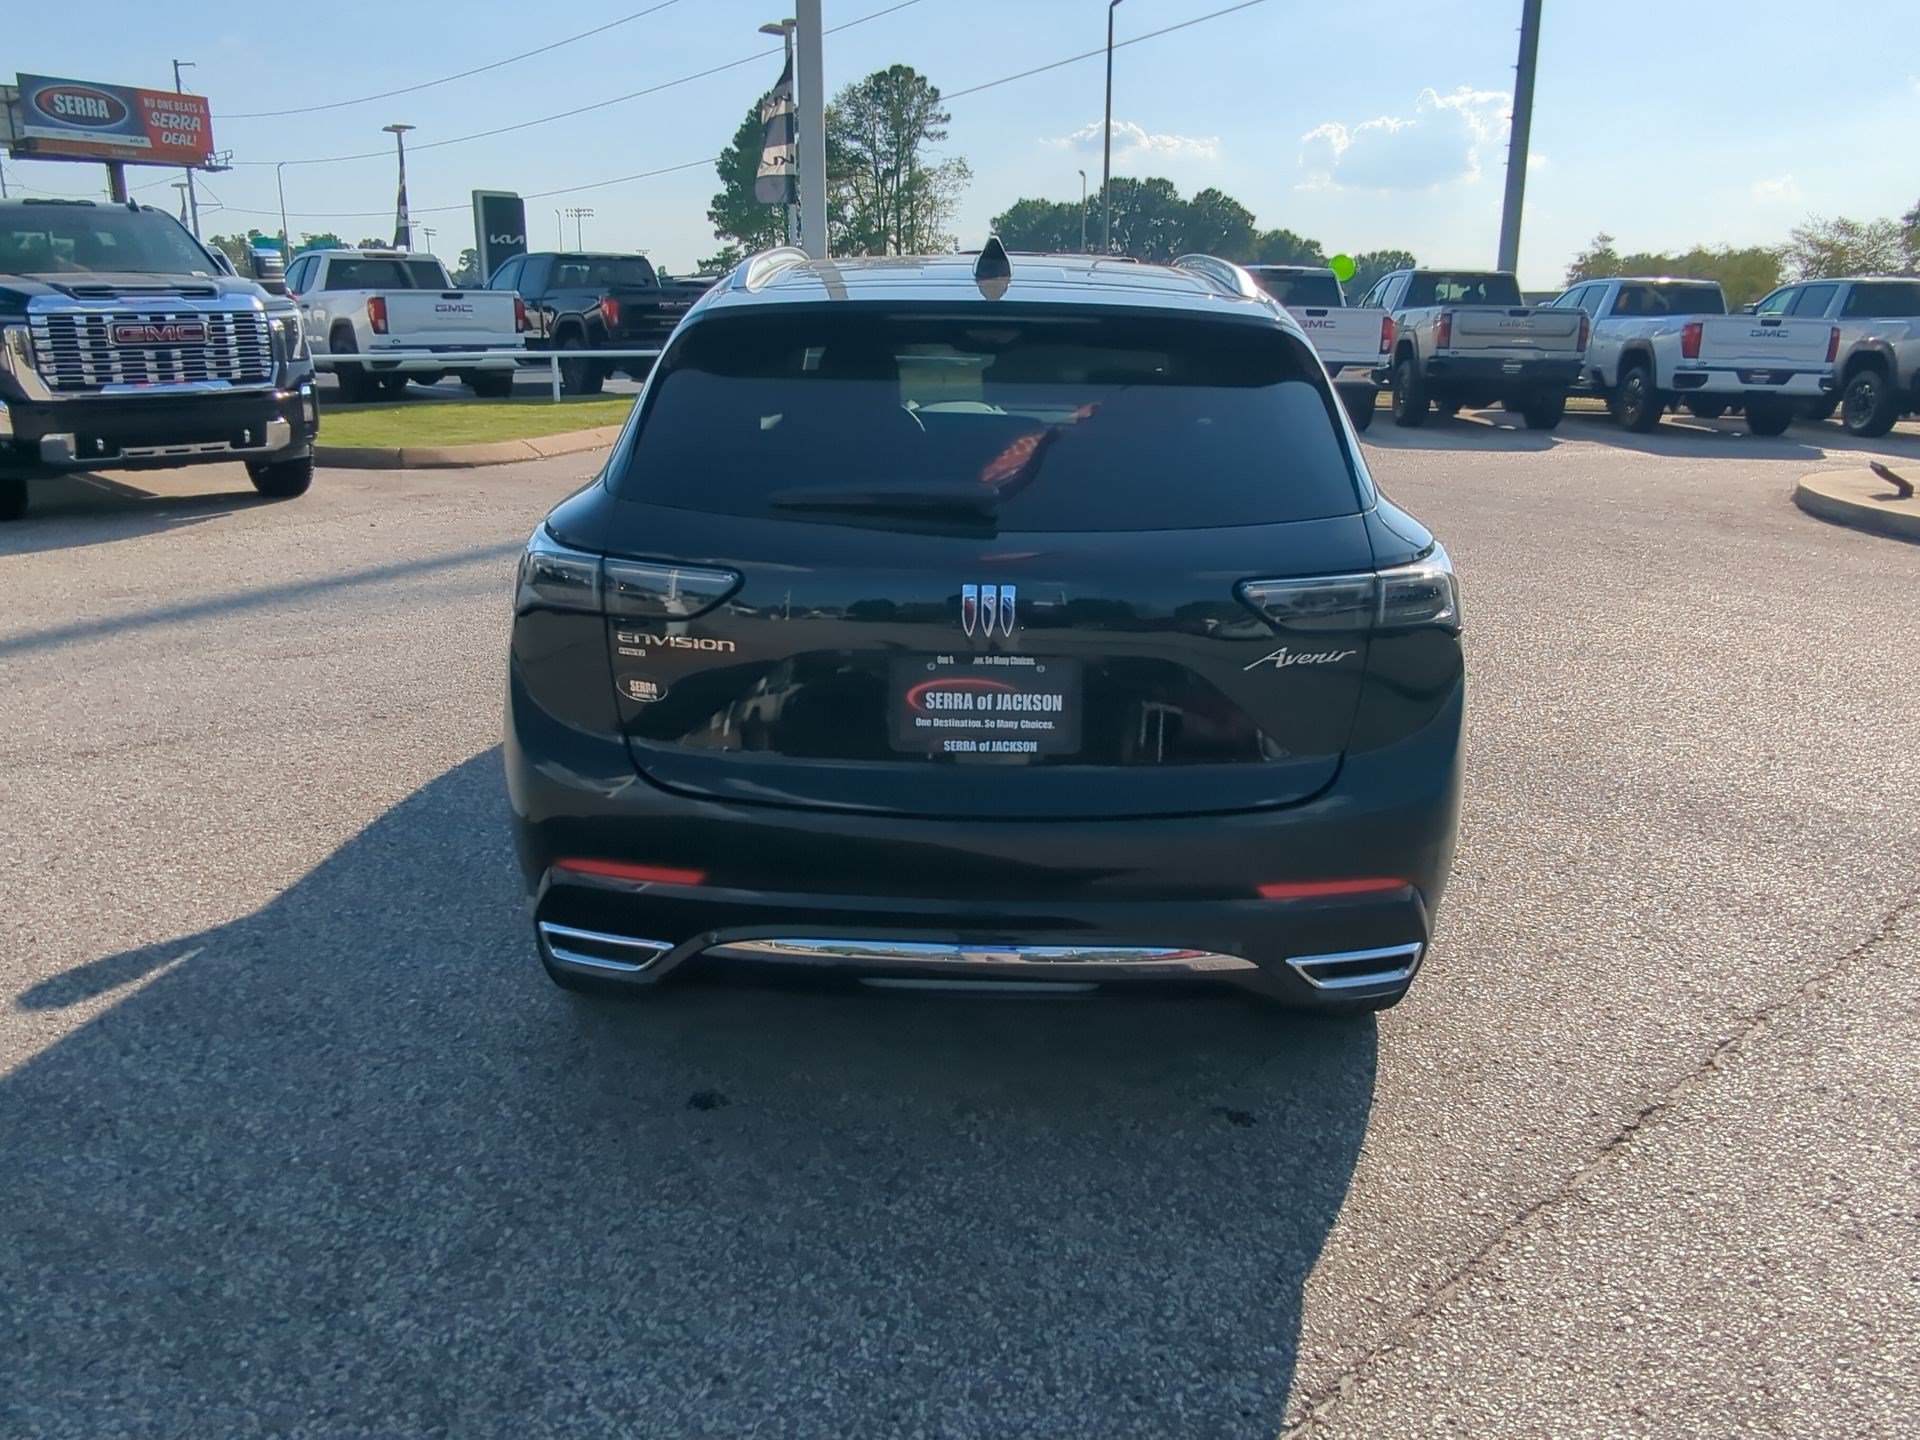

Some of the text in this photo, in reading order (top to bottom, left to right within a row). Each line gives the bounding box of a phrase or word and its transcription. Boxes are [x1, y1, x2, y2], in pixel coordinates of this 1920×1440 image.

[53, 93, 110, 118] SERRA
[144, 97, 205, 113] NO ONE BEATS A
[151, 111, 201, 132] SERRA
[162, 131, 197, 146] DEAL!
[435, 304, 473, 312] GMC
[116, 325, 204, 341] GMC
[1750, 329, 1789, 338] GMC
[617, 631, 735, 652] ENVISION
[1243, 647, 1357, 671] Avenir
[629, 680, 657, 694] SERRA
[925, 692, 1062, 711] SERRA of JACKSON
[915, 717, 1055, 730] One Destination. So Many Choices.
[943, 740, 1038, 752] SERRA of JACKSON
